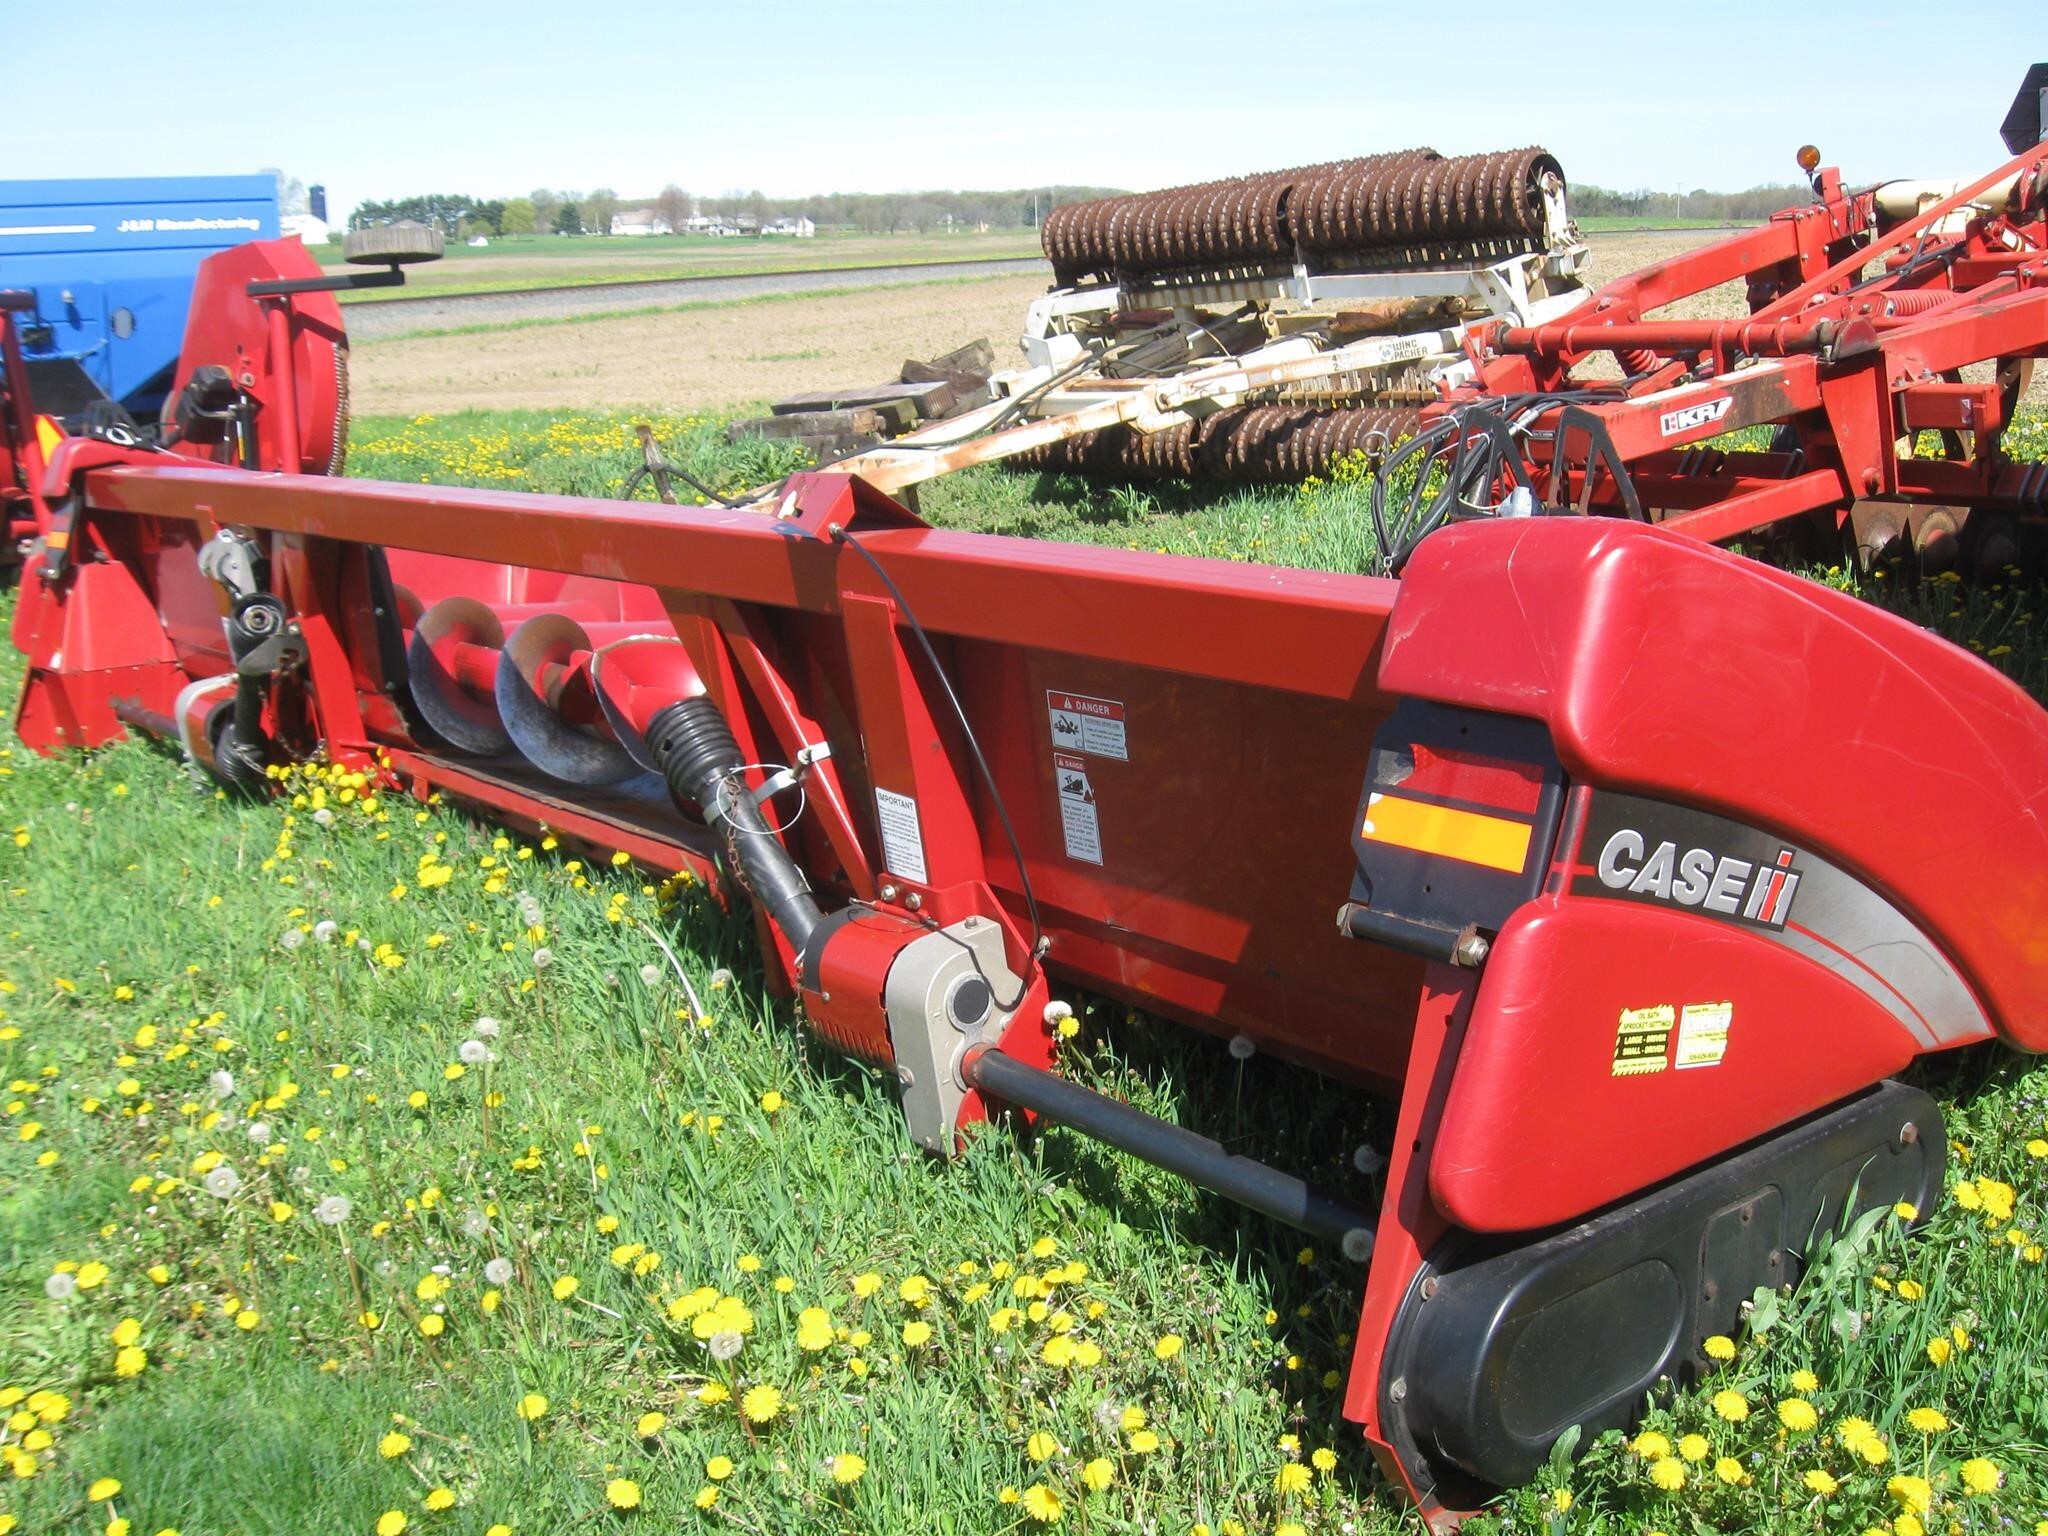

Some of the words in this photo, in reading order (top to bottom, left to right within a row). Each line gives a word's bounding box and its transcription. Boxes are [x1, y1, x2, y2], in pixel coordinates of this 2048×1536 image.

[117, 219, 154, 232] J&M
[156, 217, 261, 231] Manufacturing
[1075, 701, 1110, 715] DANGER
[878, 792, 913, 810] IMPORTANT
[1598, 828, 1752, 915] CASE
[1623, 1021, 1648, 1030] SPROCKET
[1624, 1035, 1643, 1045] LARGE
[1646, 1033, 1667, 1043] DRIVER
[1622, 1047, 1641, 1056] SMALL
